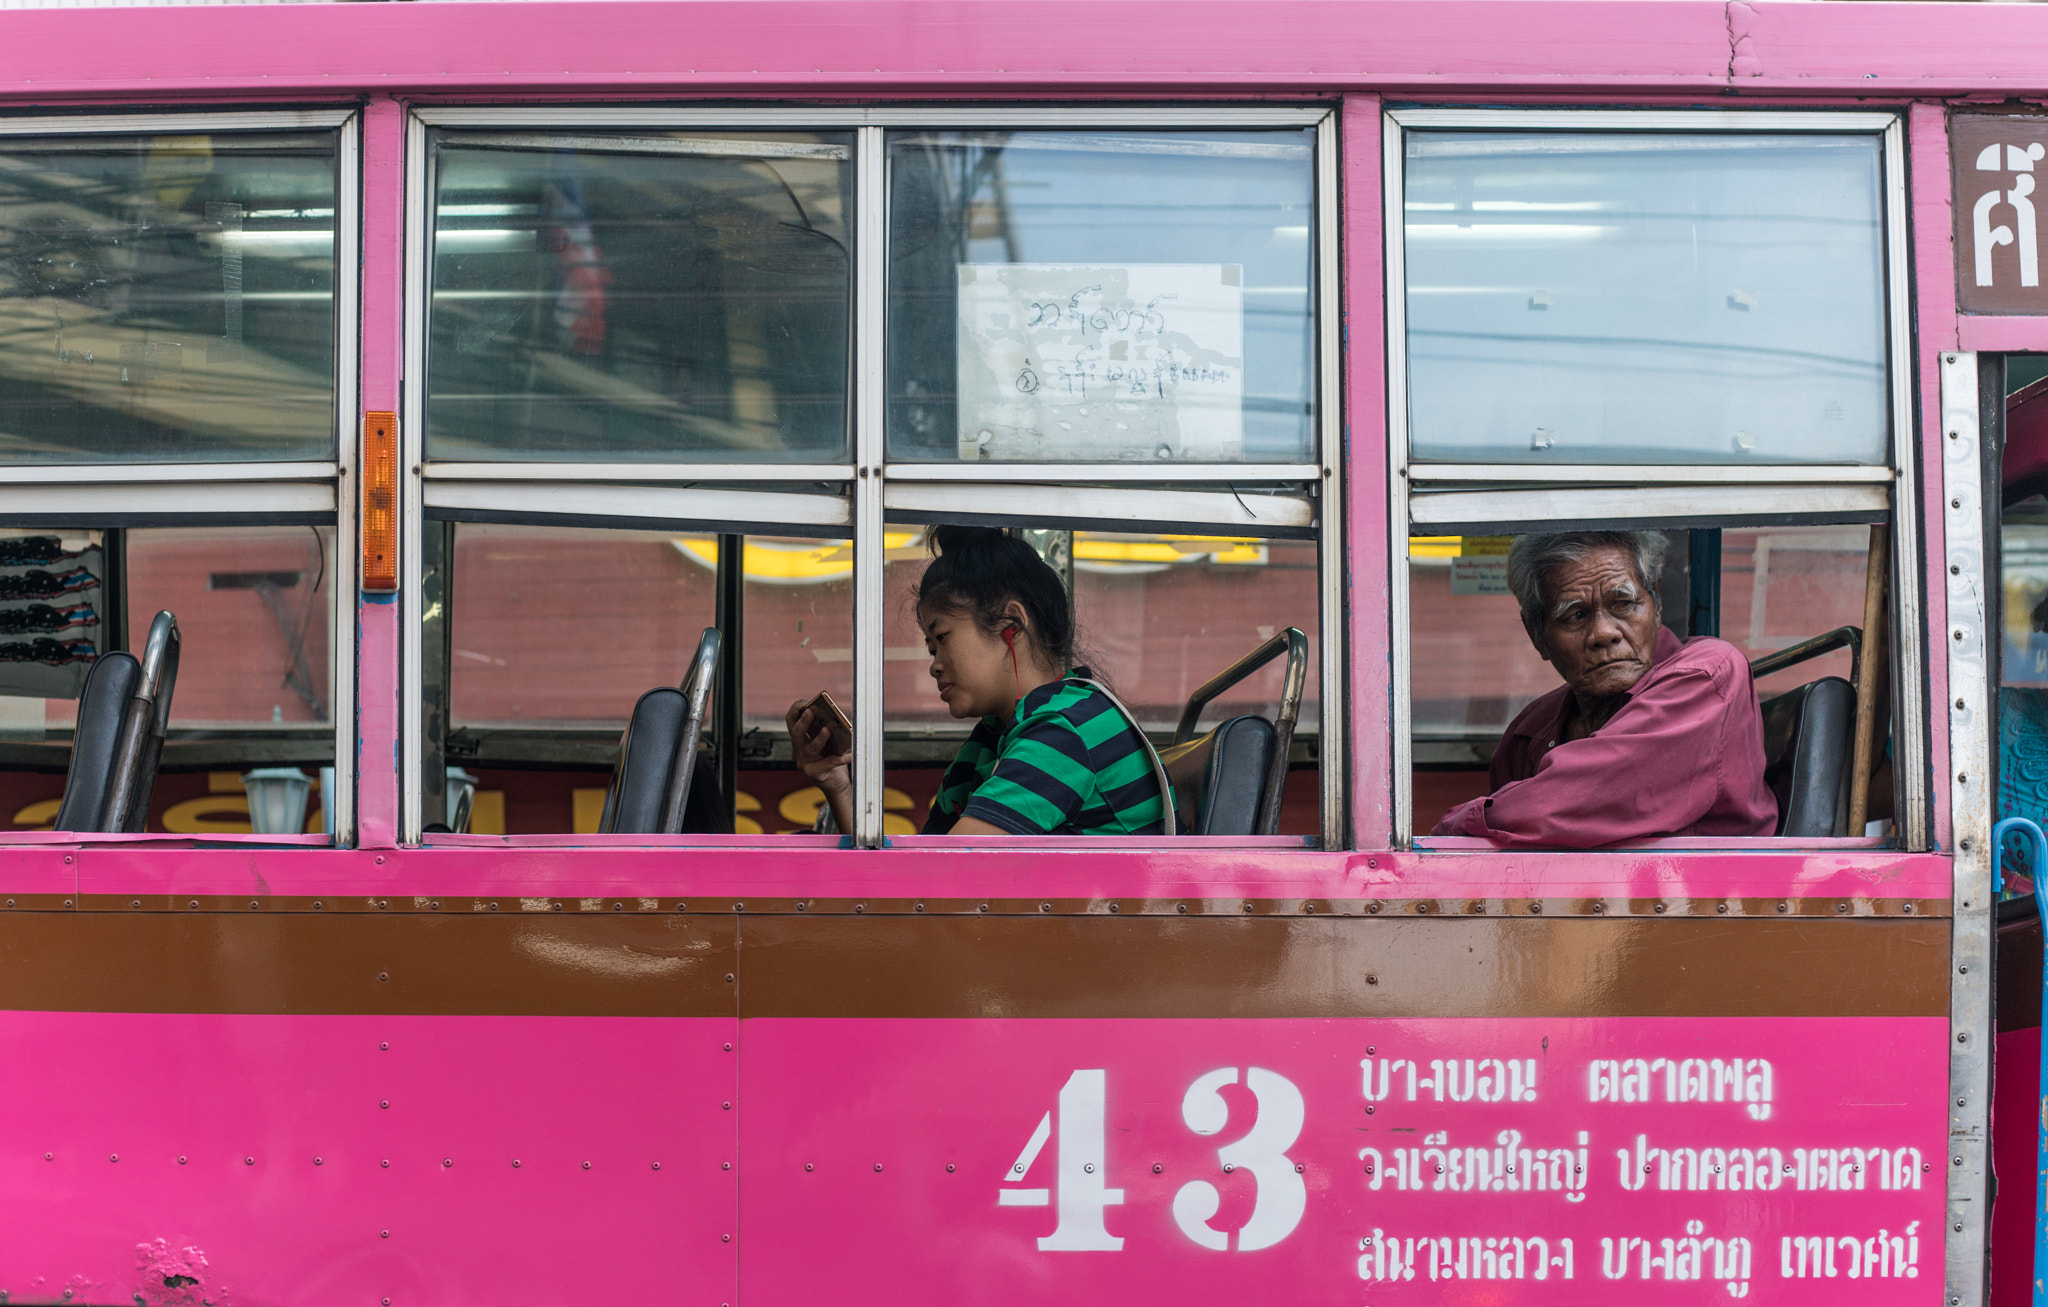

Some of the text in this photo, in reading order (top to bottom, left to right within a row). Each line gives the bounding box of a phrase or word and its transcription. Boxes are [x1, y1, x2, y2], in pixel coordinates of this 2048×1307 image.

[1360, 1057, 1774, 1121] บางบอน ตลาดพลู
[998, 1066, 1307, 1252] 43
[1358, 1129, 1922, 1203] วงเวียนใหญ่ ปากคลองตลาด
[1357, 1219, 1920, 1299] สนามหลวง บางลำภู เทเวศน์
